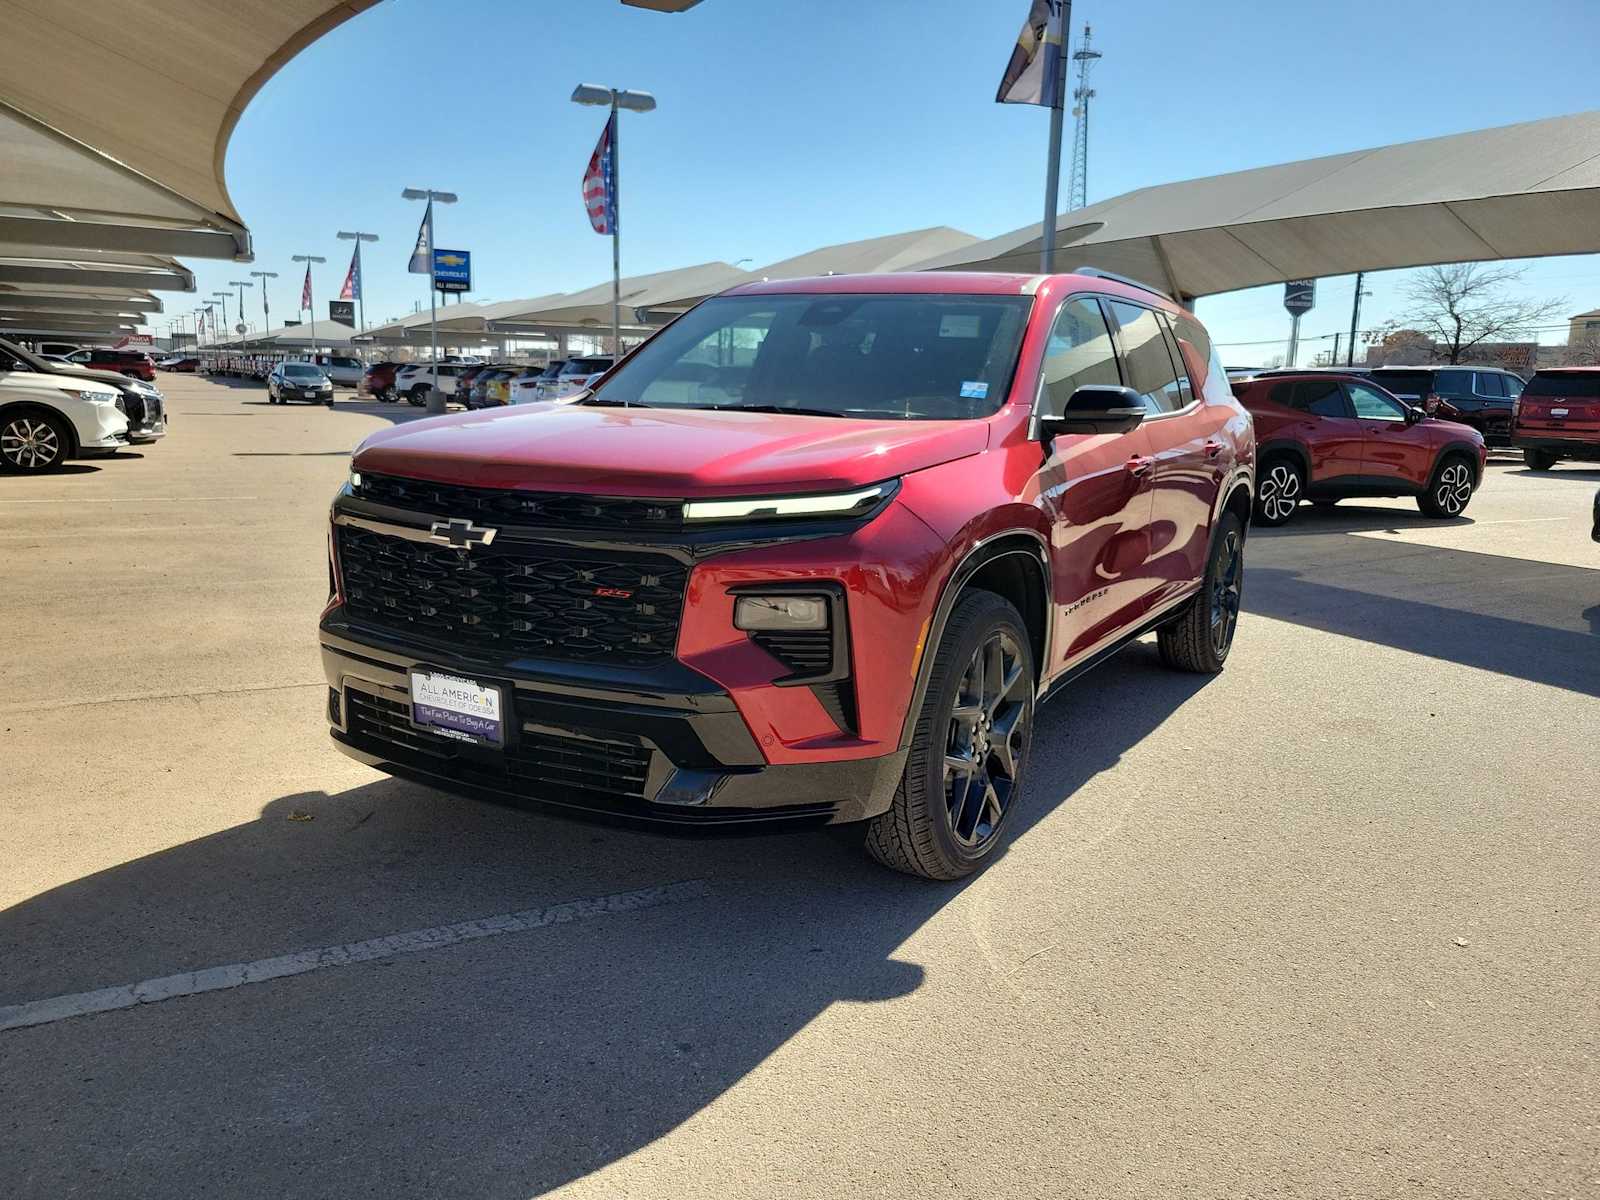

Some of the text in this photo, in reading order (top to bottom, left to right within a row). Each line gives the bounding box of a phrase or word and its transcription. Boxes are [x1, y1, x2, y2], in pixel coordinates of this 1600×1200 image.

[421, 683, 438, 695] ALL
[420, 693, 457, 707] CHEVROLET
[459, 701, 466, 709] OF
[421, 707, 431, 716] The
[467, 717, 478, 729] Buy
[485, 722, 495, 731] Car
